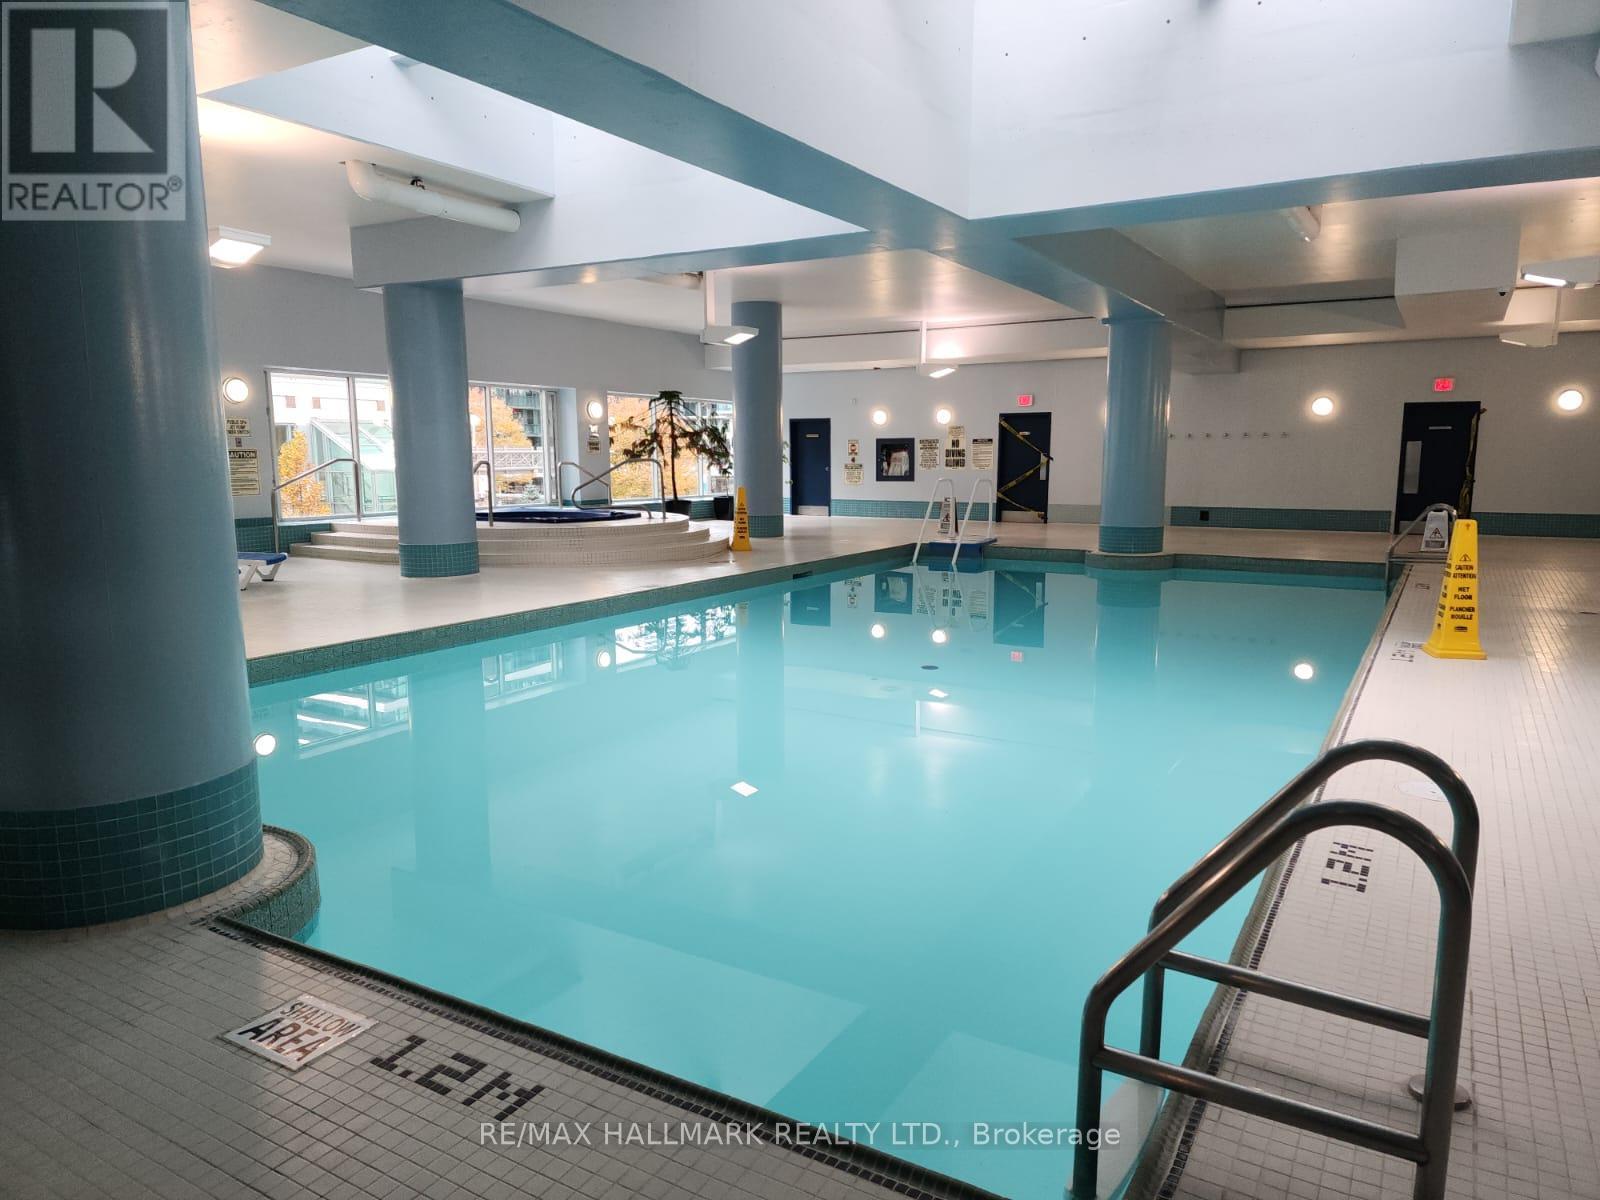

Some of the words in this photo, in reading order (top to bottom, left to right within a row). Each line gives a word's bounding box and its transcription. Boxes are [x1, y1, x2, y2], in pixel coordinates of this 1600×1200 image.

[945, 449, 965, 457] DIVING
[237, 1017, 332, 1062] AREA
[279, 1002, 361, 1038] SHALLOW
[369, 1034, 546, 1122] 1.2M
